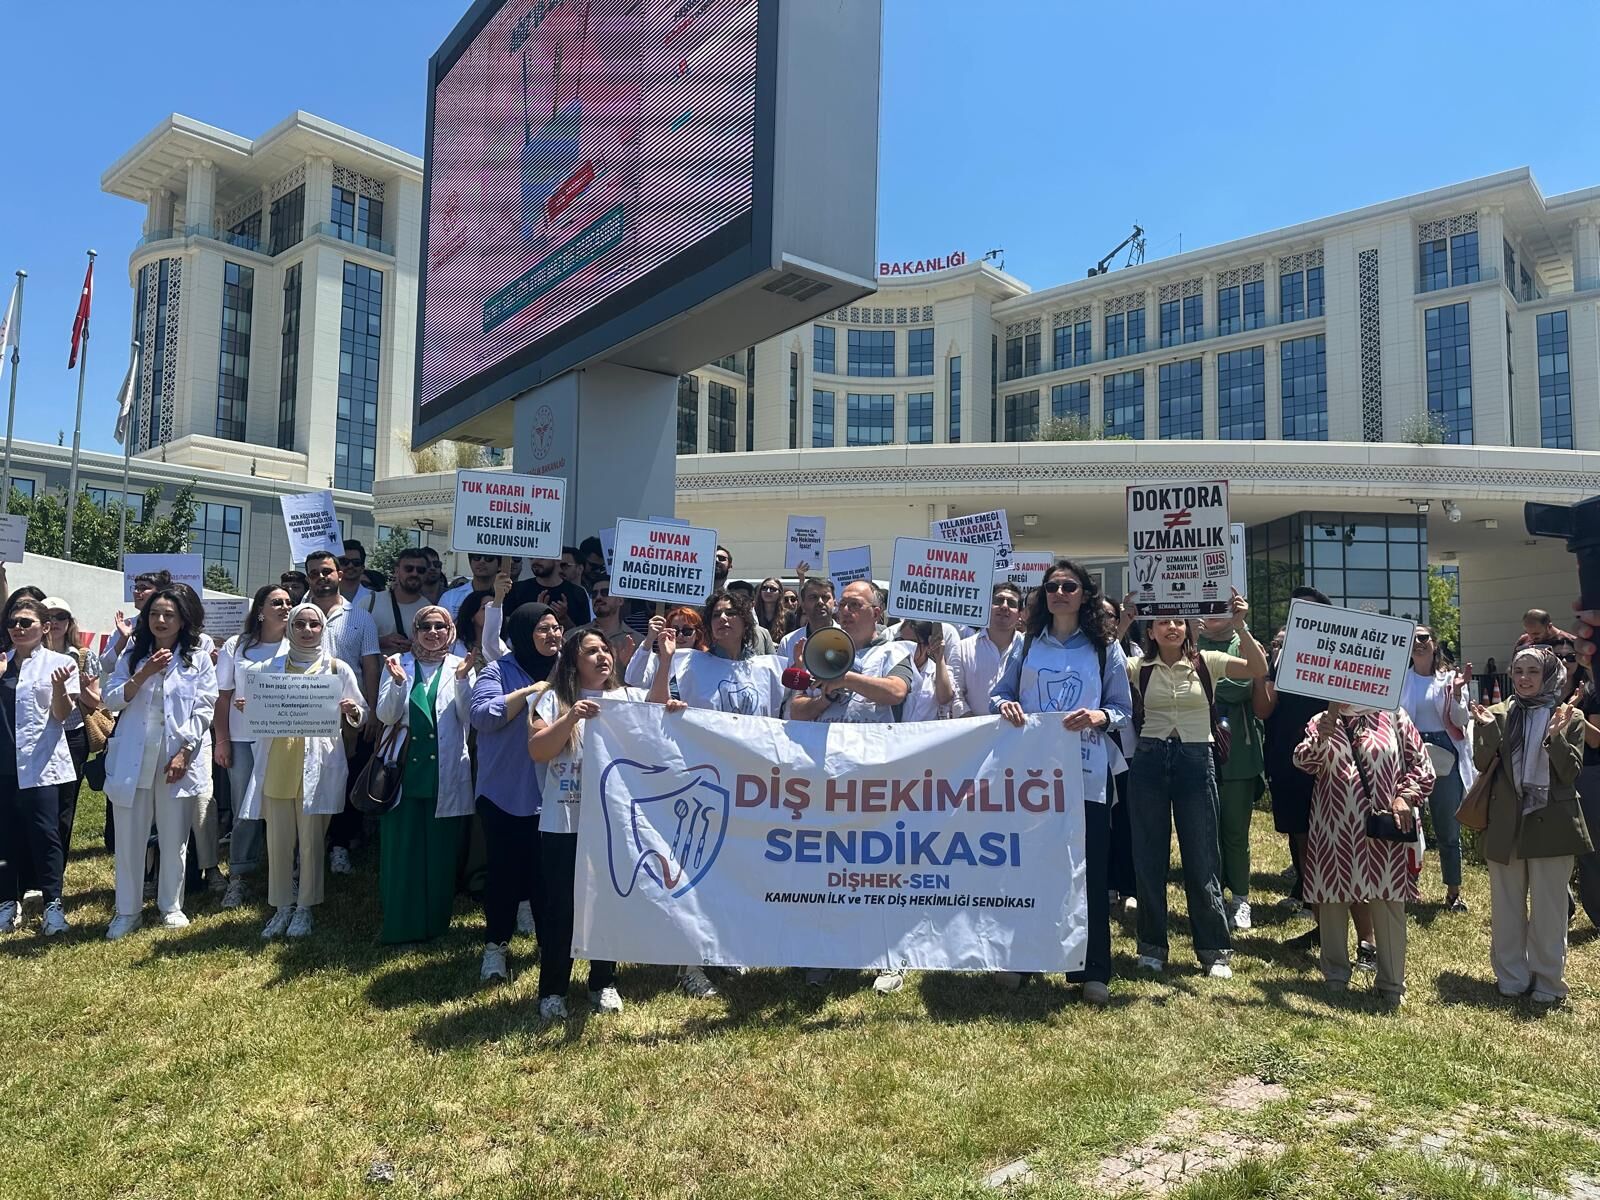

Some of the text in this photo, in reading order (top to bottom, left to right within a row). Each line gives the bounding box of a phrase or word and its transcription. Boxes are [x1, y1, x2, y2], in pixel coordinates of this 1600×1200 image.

[880, 251, 965, 275] BAKANLIĞI
[462, 481, 560, 500] TUK KARARI İPTAL
[1133, 485, 1222, 511] DOKTORA
[490, 499, 533, 516] EDİLSİN,
[467, 515, 551, 532] MESLEKİ BİRLİK
[939, 512, 999, 529] YILLARIN EMEĞİ
[941, 521, 1002, 539] TEK KARARLA
[477, 533, 538, 548] KORUNSUN!
[650, 531, 690, 546] UNVAN
[1134, 527, 1224, 550] UZMANLIK
[630, 545, 698, 563] DAĞITARAK
[927, 548, 968, 564] UNVAN
[1166, 555, 1197, 563] UZMANLIK
[1206, 553, 1224, 565] DUS
[622, 560, 702, 580] MAĞDURİYET
[908, 564, 975, 582] DAĞITARAK
[1008, 573, 1027, 582] EMEĞİ
[1161, 572, 1199, 580] KAZANILIR!
[619, 575, 705, 596] GİDERİLEMEZ!
[900, 580, 980, 600] MAĞDURİYET
[896, 596, 982, 618] GİDERİLEMEZ!
[1296, 617, 1406, 647] TOPLUMUN AĞIZ VE
[1317, 637, 1385, 660] DİŞ SAĞLIĞI
[1296, 652, 1392, 680] KENDİ KADERİNE
[1296, 669, 1389, 696] TERK EDİLEMEZ!
[735, 766, 1065, 820] DİŞ HEKİMLİĞİ
[764, 820, 1021, 867] SENDİKASI
[827, 868, 950, 892] DİŞHEK-SEN
[765, 891, 1035, 908] KAMUNUN İLK ve TEK DİŞ HEKİMLİĞİ SENDİKASI
